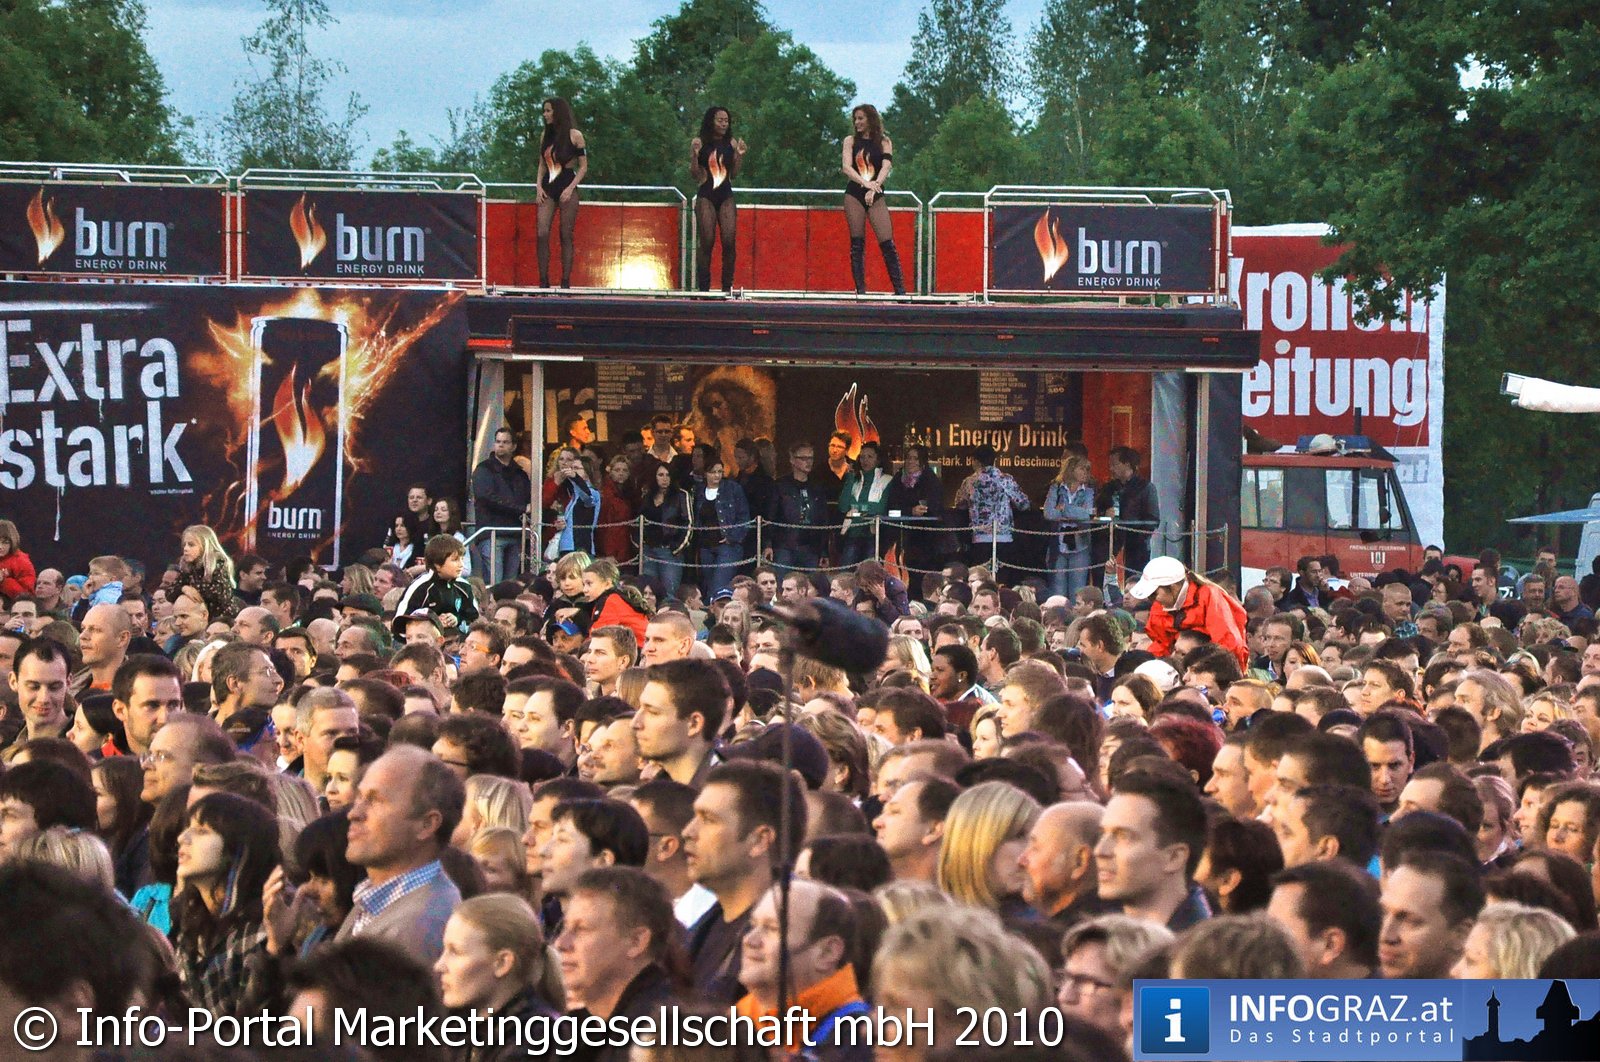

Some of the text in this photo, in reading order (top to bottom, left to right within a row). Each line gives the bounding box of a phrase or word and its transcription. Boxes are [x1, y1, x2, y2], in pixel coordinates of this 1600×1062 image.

[75, 207, 167, 257] burn
[336, 213, 425, 262] burn
[75, 259, 167, 270] ENERGY DRINK
[1078, 227, 1161, 275] burn
[336, 264, 425, 274] ENERGY DRINK
[1078, 277, 1161, 287] ENERGY DRINK
[0, 319, 180, 403] Extra
[949, 423, 1013, 452] Energy
[1019, 423, 1068, 447] Drink
[1000, 454, 1012, 467] im
[1013, 455, 1063, 468] Geschmac
[268, 500, 322, 530] burn
